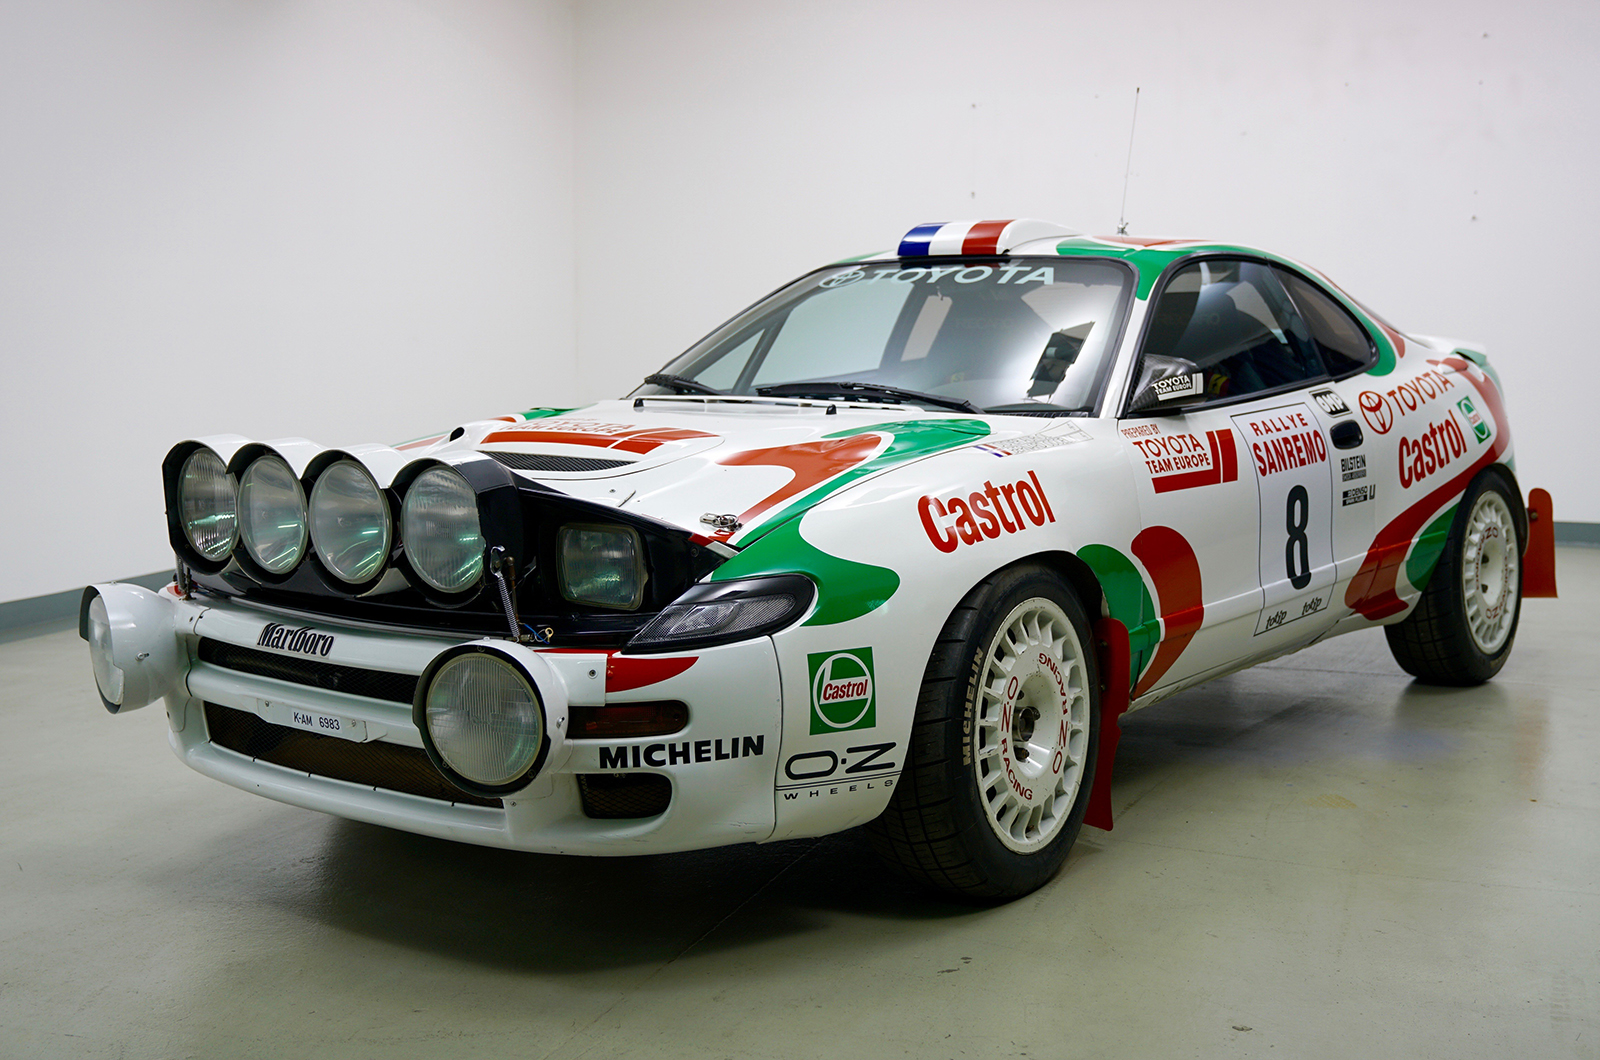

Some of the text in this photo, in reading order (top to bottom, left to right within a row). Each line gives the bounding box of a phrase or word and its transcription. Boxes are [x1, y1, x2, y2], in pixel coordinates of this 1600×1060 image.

[866, 266, 1054, 285] TOYOTA
[1152, 375, 1190, 389] TOYOTA
[1155, 386, 1172, 394] TEAM
[1387, 370, 1455, 416] TOYOTA
[1316, 393, 1343, 412] OMP
[1250, 413, 1308, 436] RALLYE
[1133, 434, 1205, 459] TOYOTA
[1252, 429, 1326, 477] SANREMO
[1399, 409, 1467, 489] Castrol
[1145, 453, 1211, 474] TEAM EUROPE
[1341, 454, 1366, 472] BILSTEIN
[917, 470, 1056, 553] Castrol
[1286, 485, 1311, 590] 8
[257, 622, 335, 656] Marlboro
[823, 679, 869, 702] Castrol
[1038, 652, 1068, 715] RACING
[963, 646, 984, 765] MICHELIN
[293, 711, 340, 730] K-AM 6983
[599, 735, 764, 768] MICHELIN
[1001, 739, 1033, 800] RACING
[784, 779, 894, 800] WHEELS
